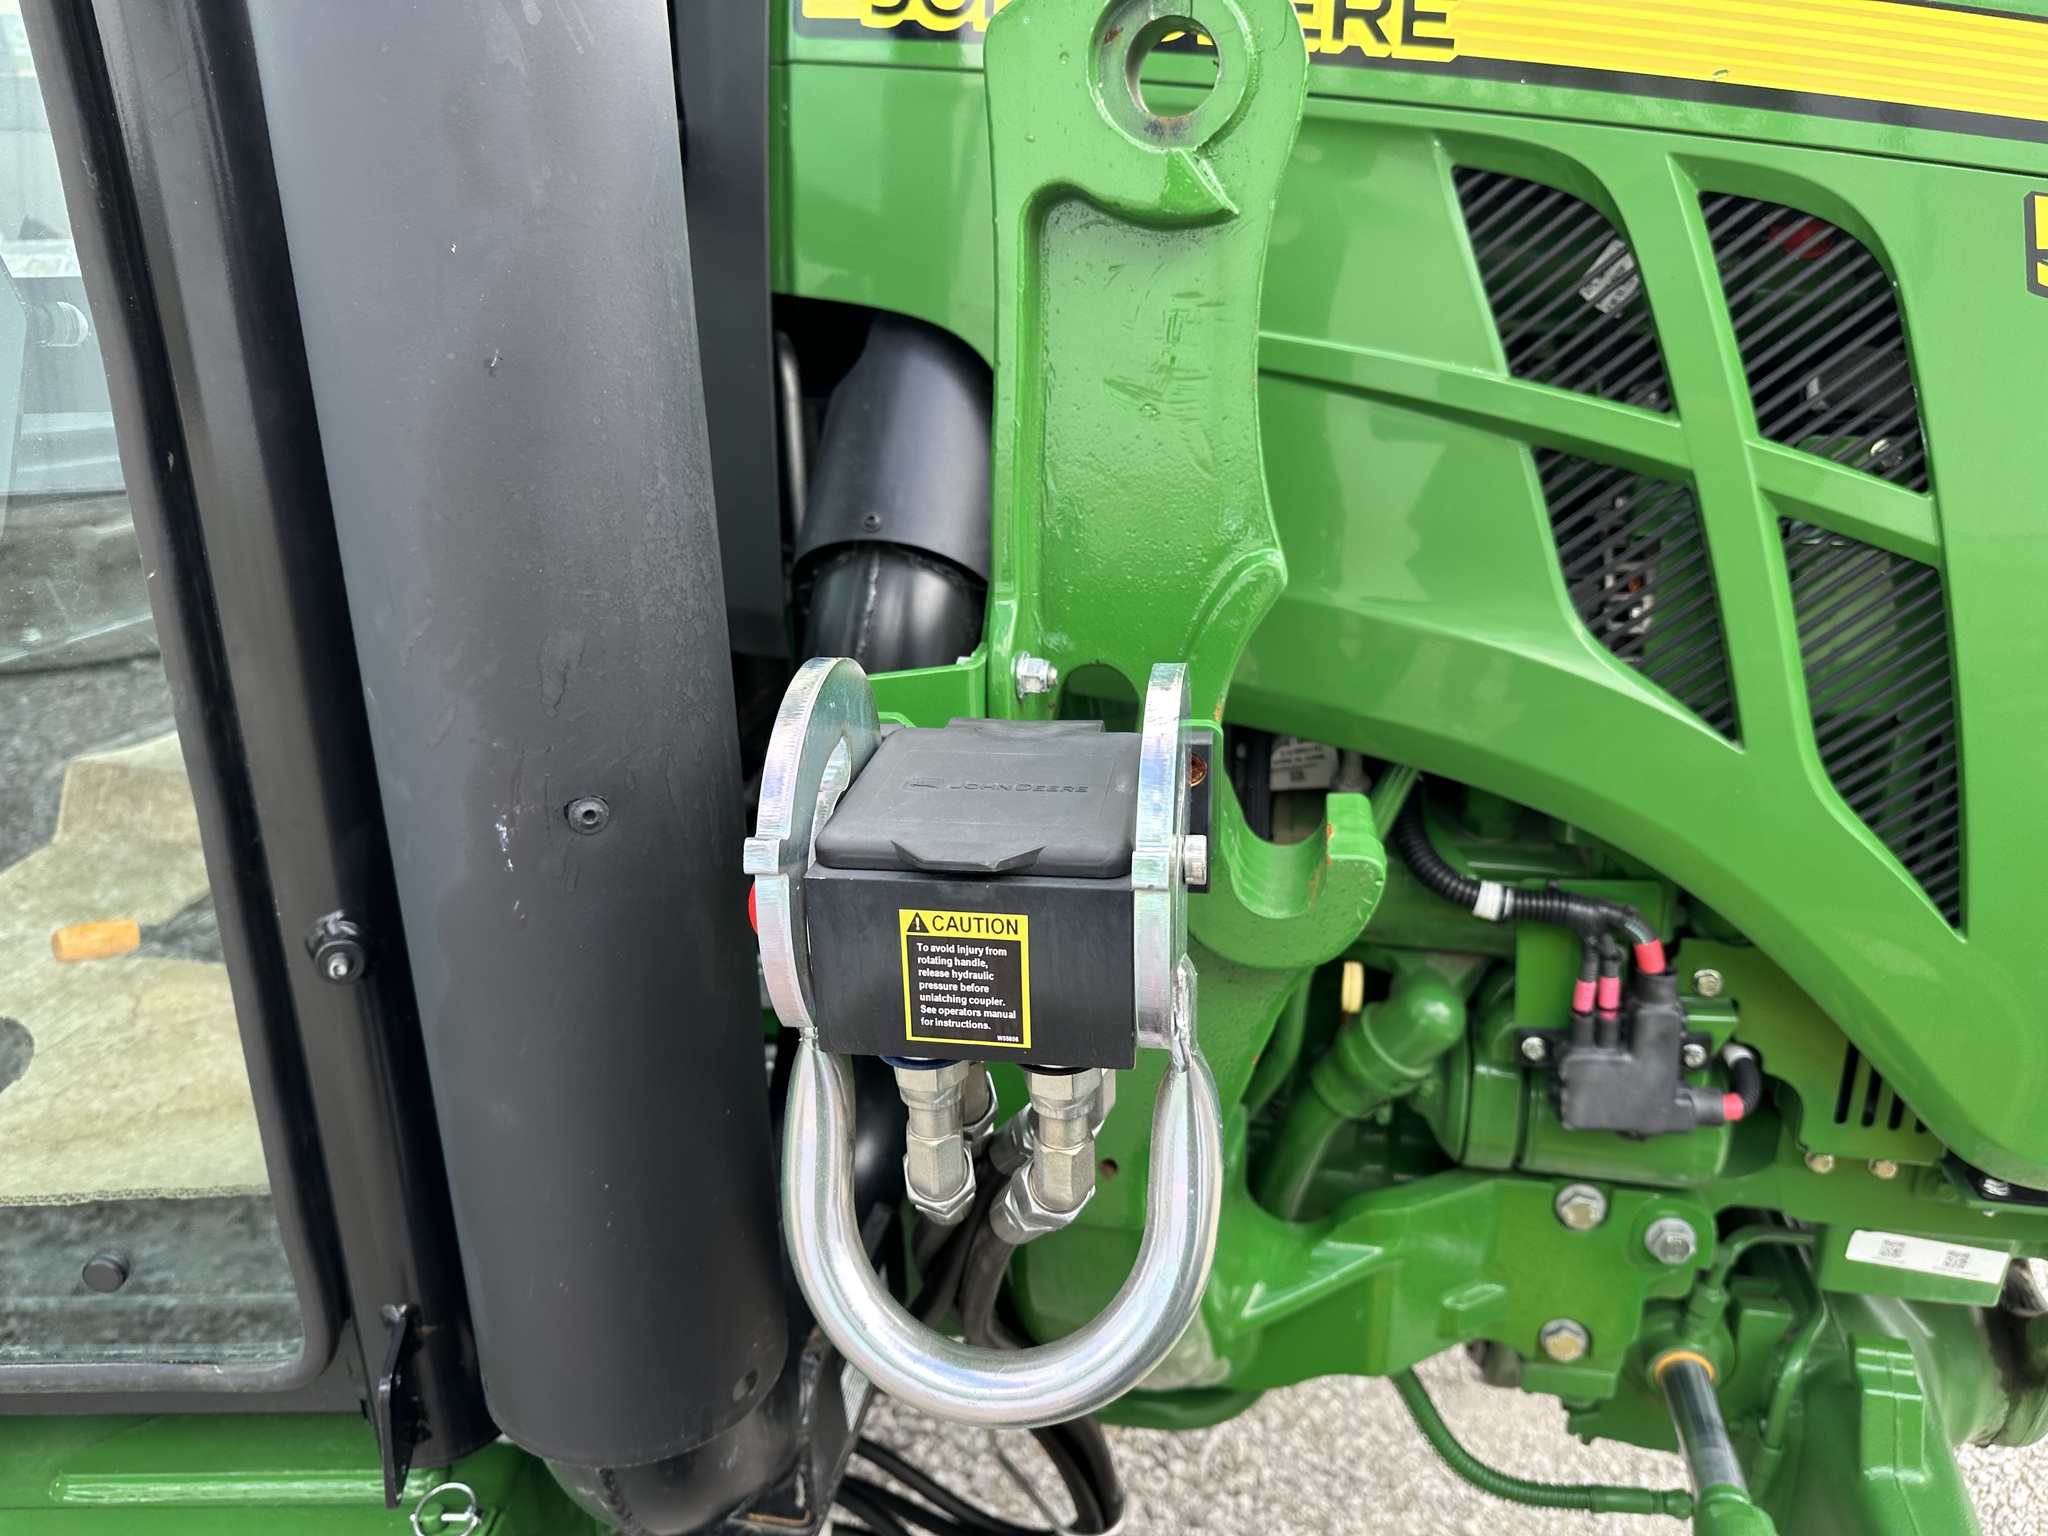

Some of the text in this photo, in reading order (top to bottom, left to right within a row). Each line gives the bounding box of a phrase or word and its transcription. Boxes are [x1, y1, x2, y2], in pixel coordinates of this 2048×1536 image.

[951, 782, 1089, 793] JOHN DEERE
[932, 915, 1019, 936] CAUTION
[917, 943, 1008, 956] To avoid injury from
[918, 956, 988, 969] rotating handle,
[918, 968, 994, 980] release hydraulic
[919, 982, 990, 993] pressure before
[920, 993, 1006, 1006] unlatching coupler.
[920, 1005, 1016, 1019] See operators manual
[920, 1017, 992, 1030] for instructions.
